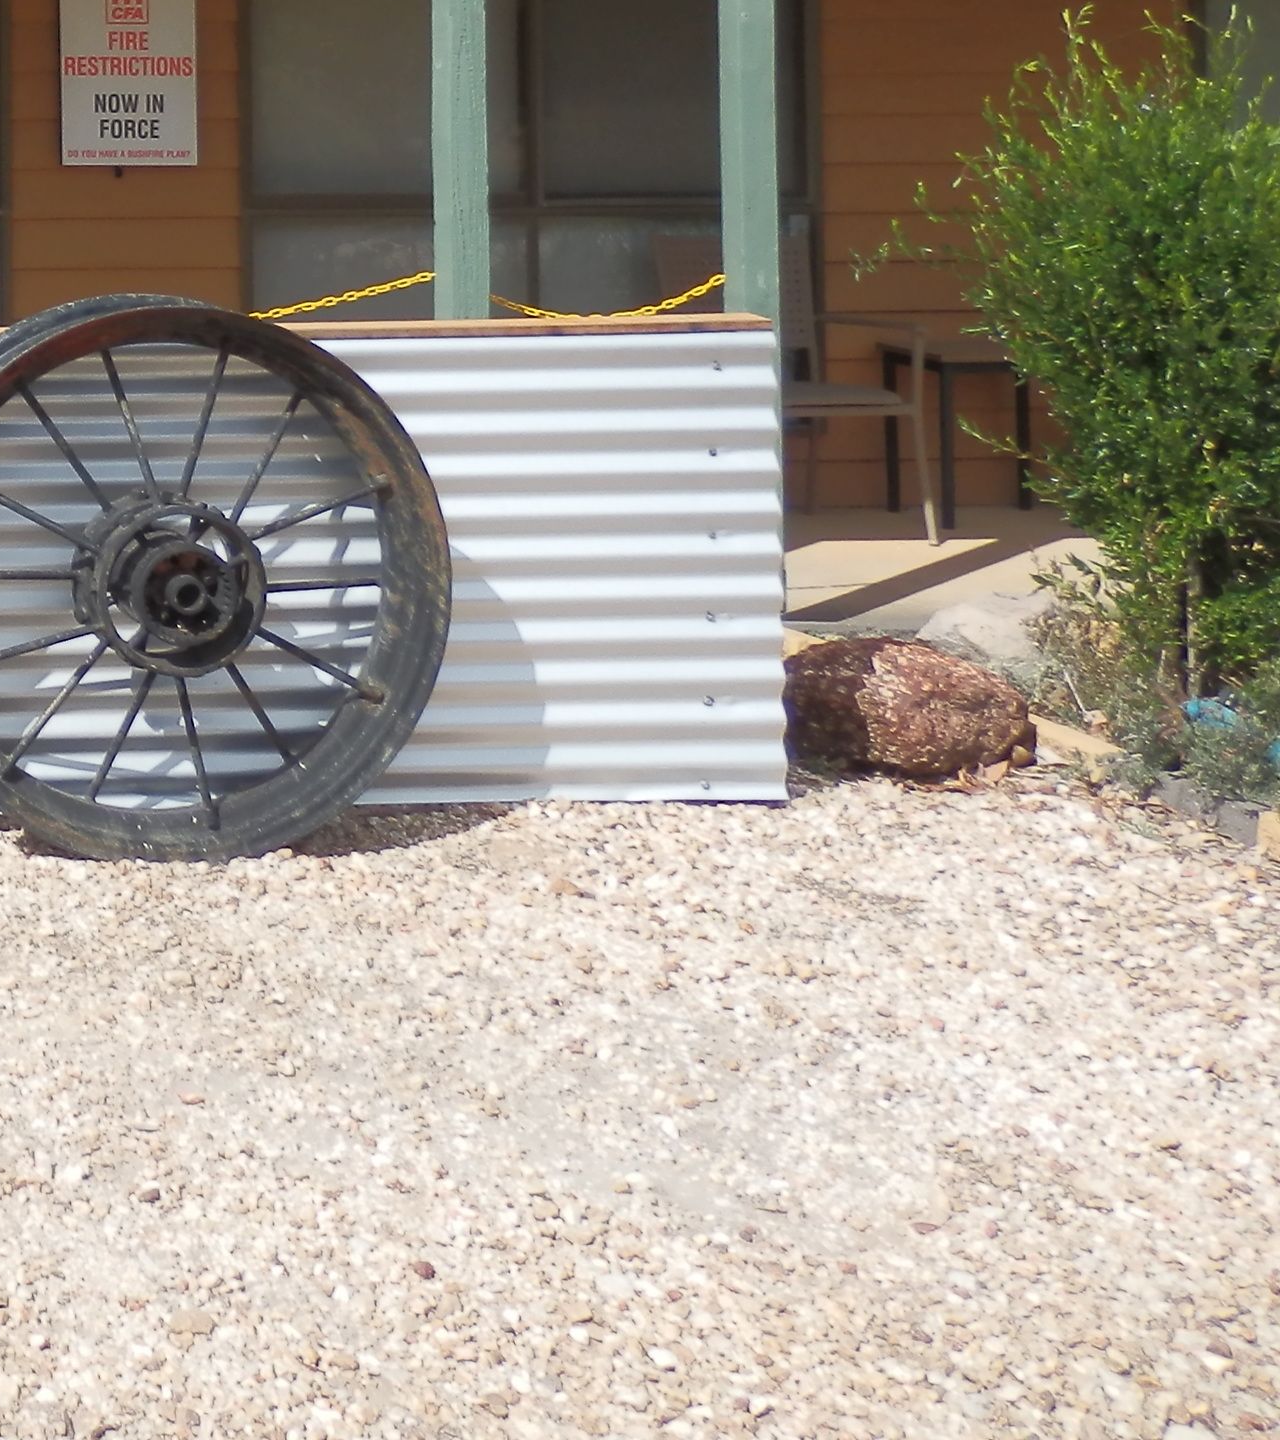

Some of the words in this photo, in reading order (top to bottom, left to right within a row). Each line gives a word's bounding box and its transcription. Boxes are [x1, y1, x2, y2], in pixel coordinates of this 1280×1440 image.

[111, 7, 144, 21] CFA
[108, 31, 149, 51] FIRE
[63, 56, 193, 77] RESTRICTIONS
[94, 93, 138, 114] NOW
[146, 93, 164, 114] IN
[99, 119, 160, 139] FORCE
[67, 150, 79, 158] DO
[81, 150, 97, 158] YOU
[99, 150, 118, 158] HAVE
[120, 150, 126, 158] A
